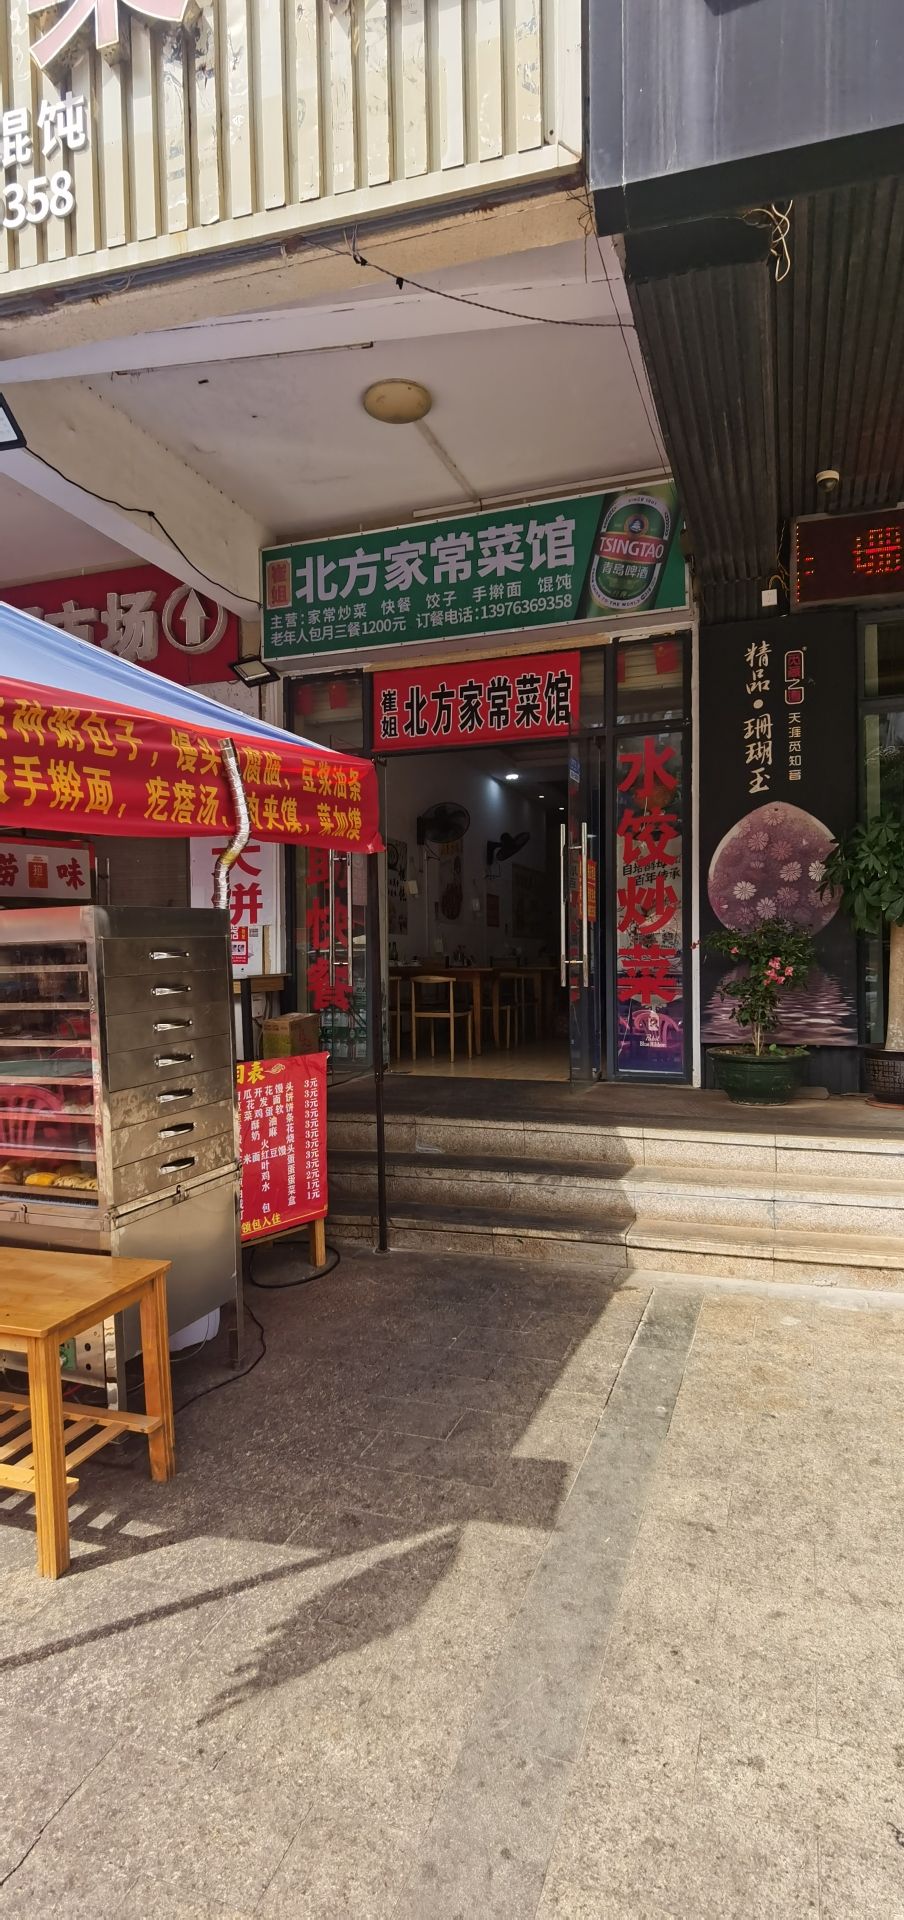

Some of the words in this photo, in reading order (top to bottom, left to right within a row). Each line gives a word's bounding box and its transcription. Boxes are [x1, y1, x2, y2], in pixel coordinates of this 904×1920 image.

[0, 170, 75, 230] 358
[600, 537, 664, 559] TSINGTAO
[296, 514, 576, 603] 北方家常菜馆
[602, 561, 649, 579] 青岛啤酒
[381, 596, 411, 614] 快餐
[425, 592, 457, 609] 饺子
[472, 581, 522, 602] 手擀面
[537, 573, 572, 593] 馄饨
[24, 590, 158, 661] 市场
[270, 615, 407, 647] 老年人包月三餐1200元
[416, 593, 573, 629] 订餐电话：13976369358
[403, 669, 573, 738] 北方家常菜馆
[380, 689, 399, 739] 崔姐
[788, 712, 802, 781] 天涯觅知音
[56, 857, 85, 890] 味
[617, 736, 679, 1004] 水饺炒菜
[303, 1077, 318, 1088] 3元
[304, 1087, 318, 1098] 3元
[304, 1098, 318, 1108] 3元
[304, 1108, 319, 1118] 3元
[304, 1118, 319, 1128] 3元
[305, 1128, 319, 1138] 3元
[305, 1138, 319, 1149] 3元
[305, 1148, 319, 1159] 3元
[306, 1158, 319, 1169] 3元
[306, 1168, 320, 1180] 2元
[306, 1178, 320, 1190] 1元
[307, 1188, 321, 1200] 1元
